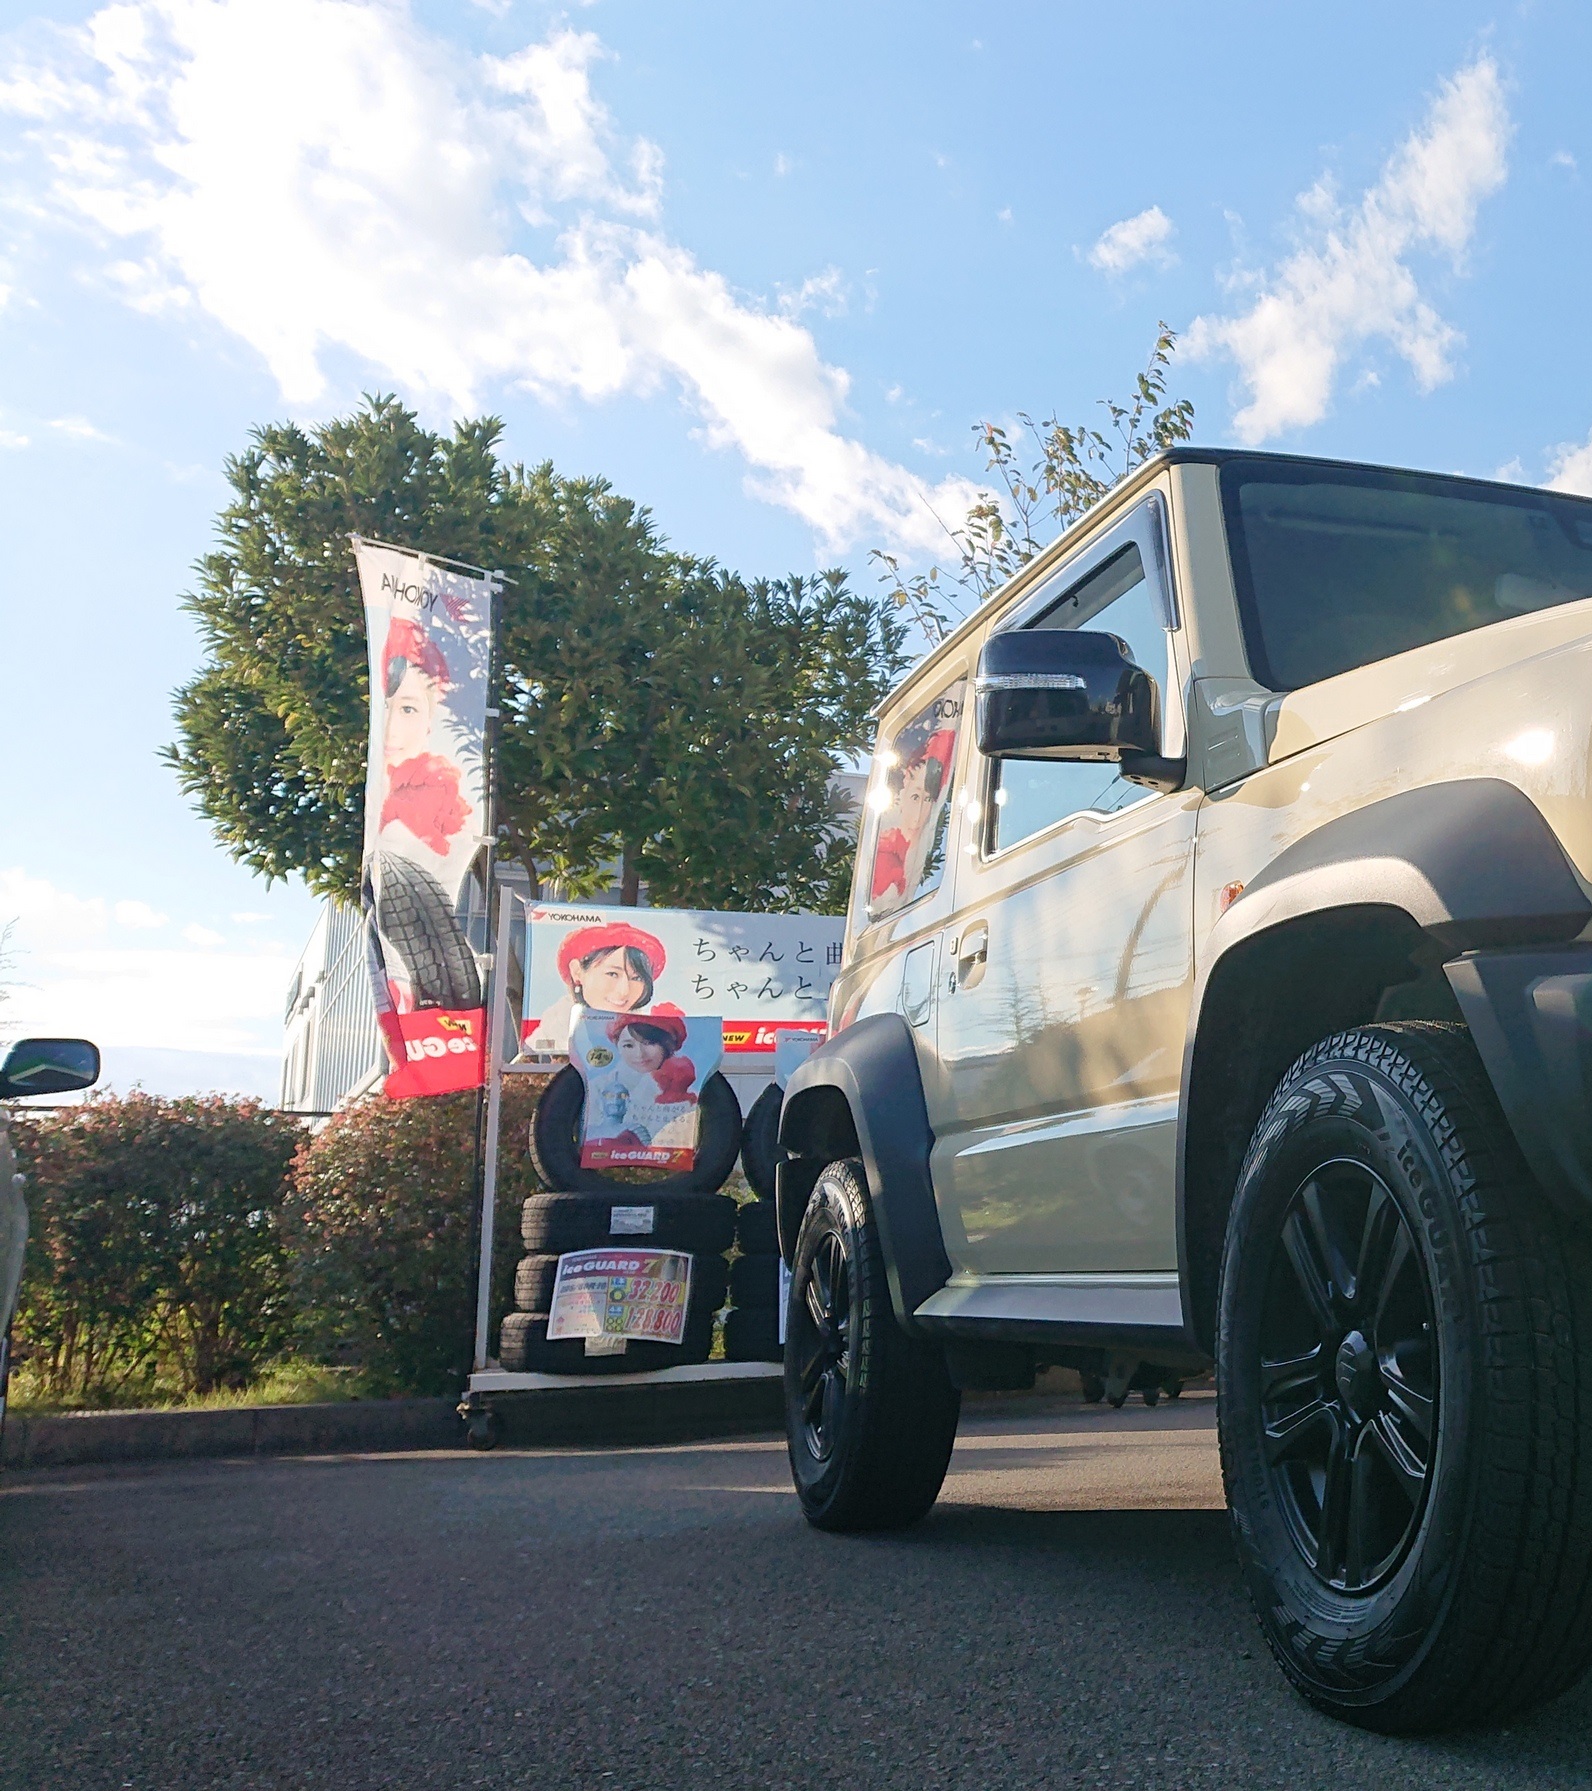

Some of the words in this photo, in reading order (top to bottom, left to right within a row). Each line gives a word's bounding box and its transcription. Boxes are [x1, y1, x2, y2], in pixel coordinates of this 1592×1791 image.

[548, 913, 602, 923] YOKOHAMA
[691, 973, 831, 1000] ちゃんと
[610, 1150, 671, 1161] iceGUARD
[671, 1150, 684, 1163] 7
[562, 1260, 640, 1276] iceGUARD
[642, 1258, 659, 1274] 7
